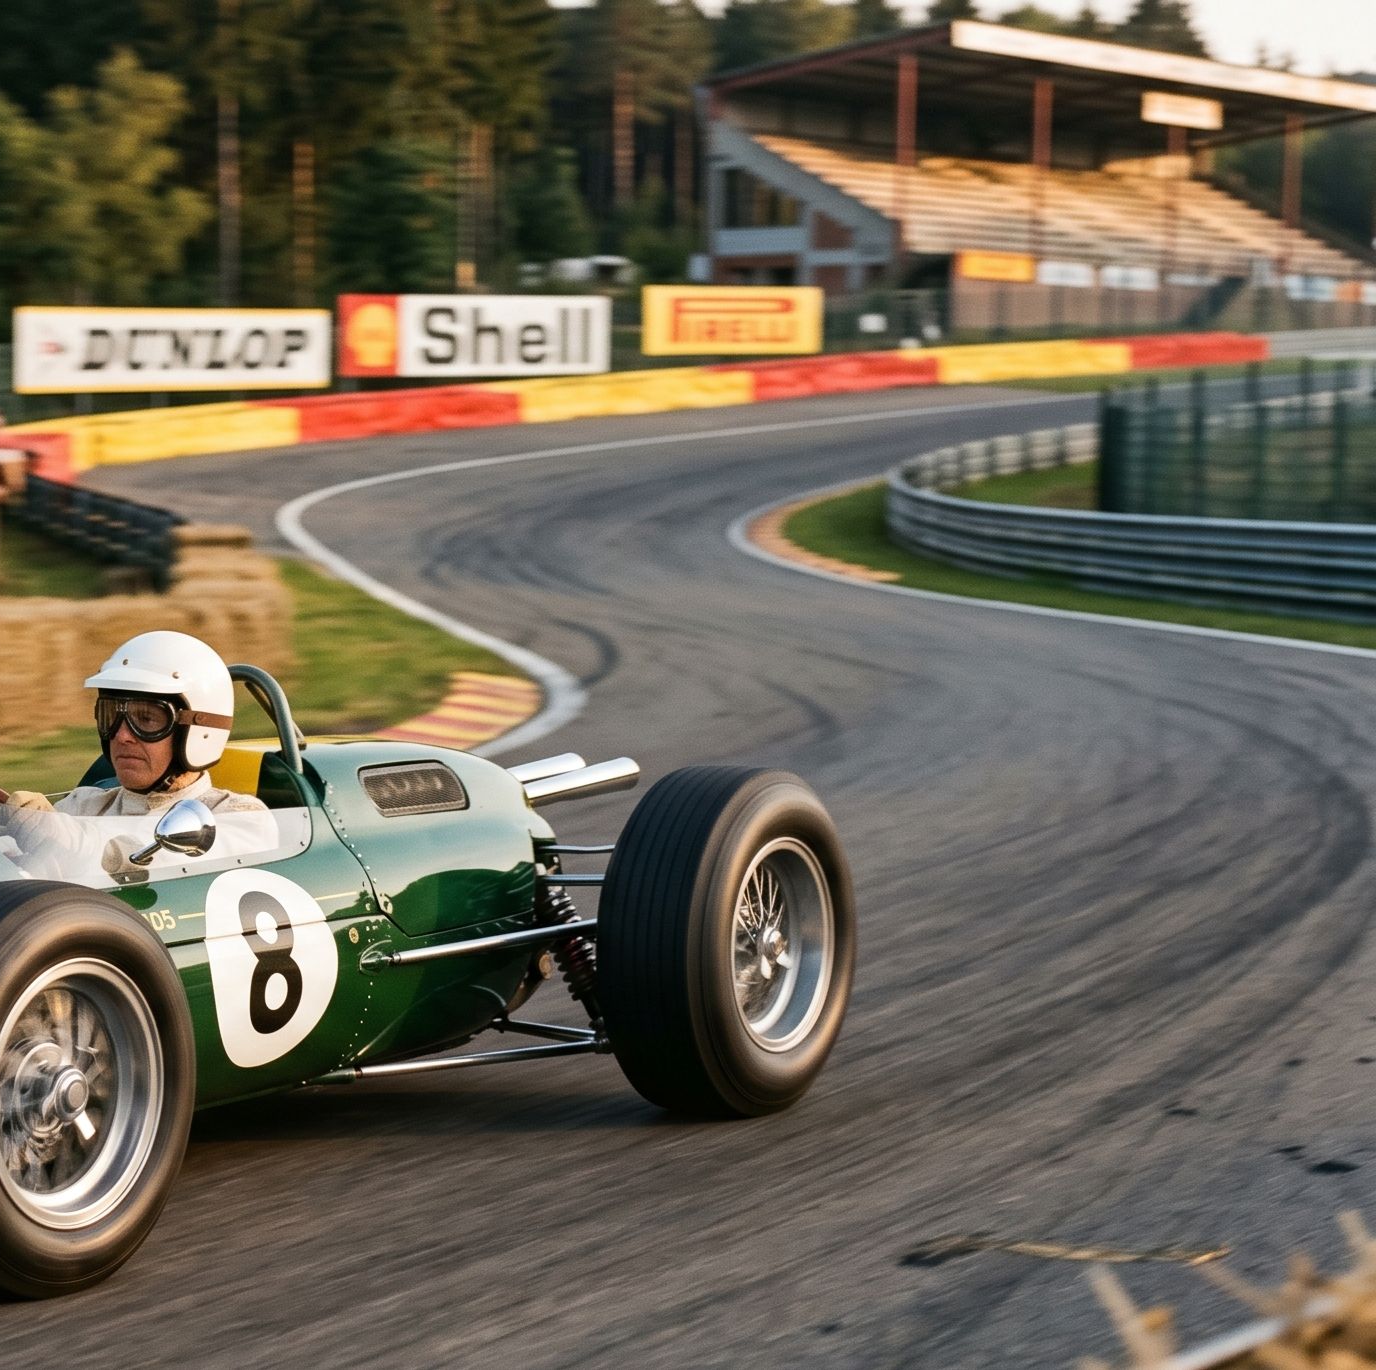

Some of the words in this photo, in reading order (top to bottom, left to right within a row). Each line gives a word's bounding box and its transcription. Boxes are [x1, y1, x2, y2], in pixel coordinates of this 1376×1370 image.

[78, 328, 311, 370] DUNLOP
[422, 306, 593, 364] Shell
[238, 890, 303, 1034] 8
